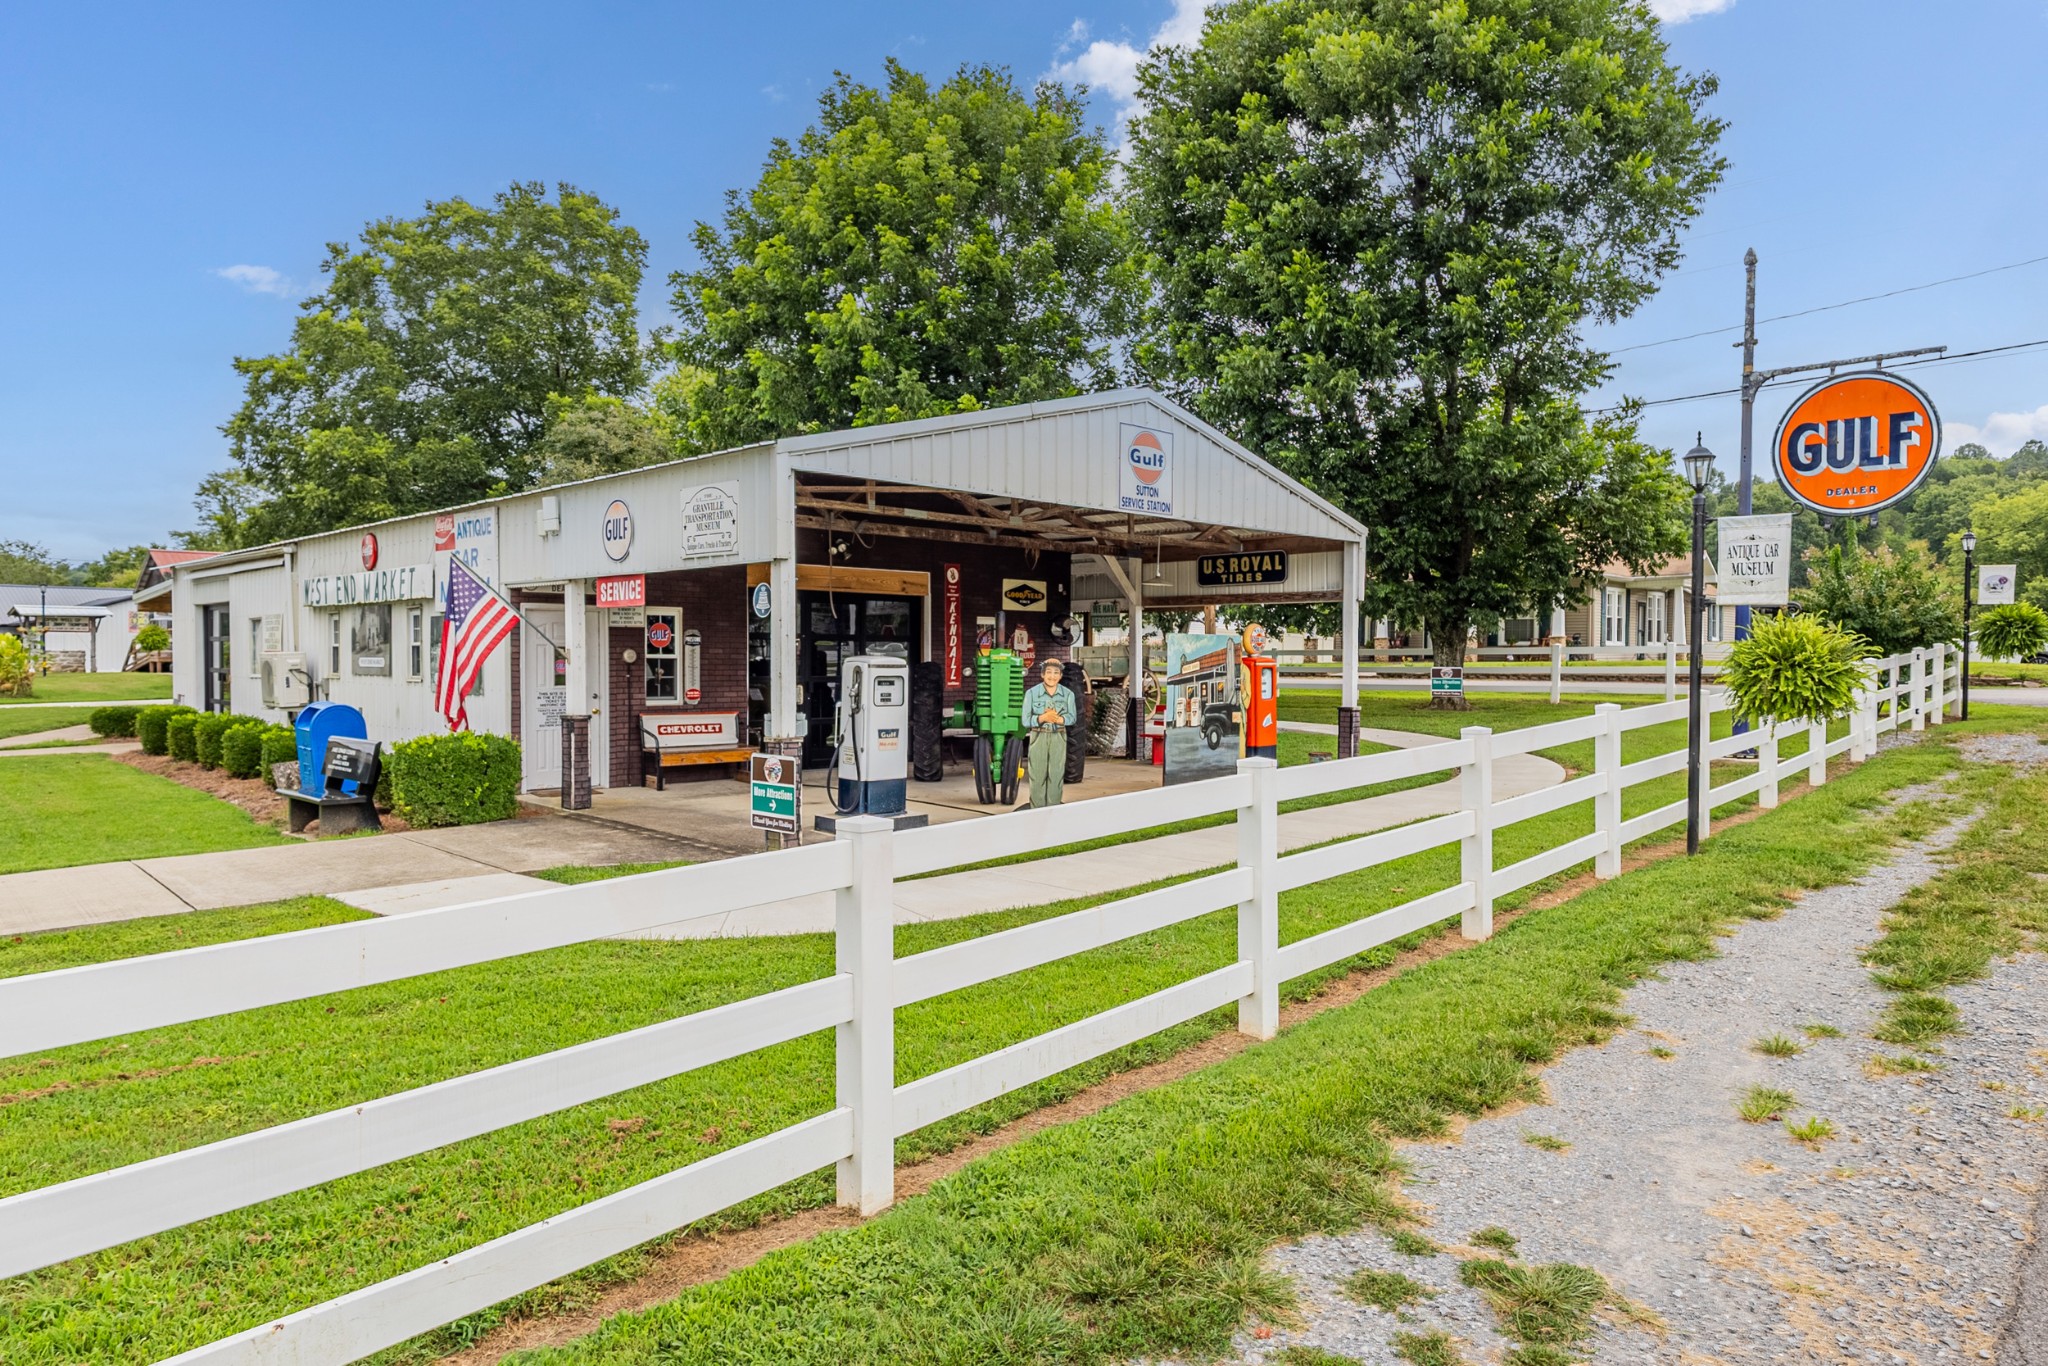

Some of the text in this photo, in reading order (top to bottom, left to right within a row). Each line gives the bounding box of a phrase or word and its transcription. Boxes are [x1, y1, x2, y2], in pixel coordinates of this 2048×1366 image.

[1787, 411, 1923, 477] GULF
[1130, 448, 1164, 467] Gulf
[1135, 484, 1159, 498] SUTTON
[1826, 485, 1879, 497] DEALER
[692, 501, 724, 513] GRANVILLE
[1121, 496, 1171, 513] SERVICE STATION
[685, 509, 734, 524] TRANSPORTATION
[456, 517, 492, 540] ANTIQUE
[605, 516, 628, 541] GULF
[696, 520, 721, 532] MUSEUM
[1727, 543, 1779, 561] ANTIQUE CAR
[1229, 555, 1282, 573] ROYAL
[1731, 561, 1774, 576] MUSEUM
[1220, 572, 1263, 583] TIRES
[303, 578, 329, 605] WEST
[336, 574, 356, 604] END
[363, 567, 416, 601] MARKET
[600, 579, 641, 602] SERVICE
[1006, 590, 1043, 600] GOODYEAR
[1102, 604, 1118, 613] HAVE
[651, 629, 669, 641] GULF
[949, 602, 958, 680] KENDALL
[660, 724, 720, 734] CHEVROLET
[880, 730, 897, 738] Gulf
[753, 786, 793, 801] More Attractions
